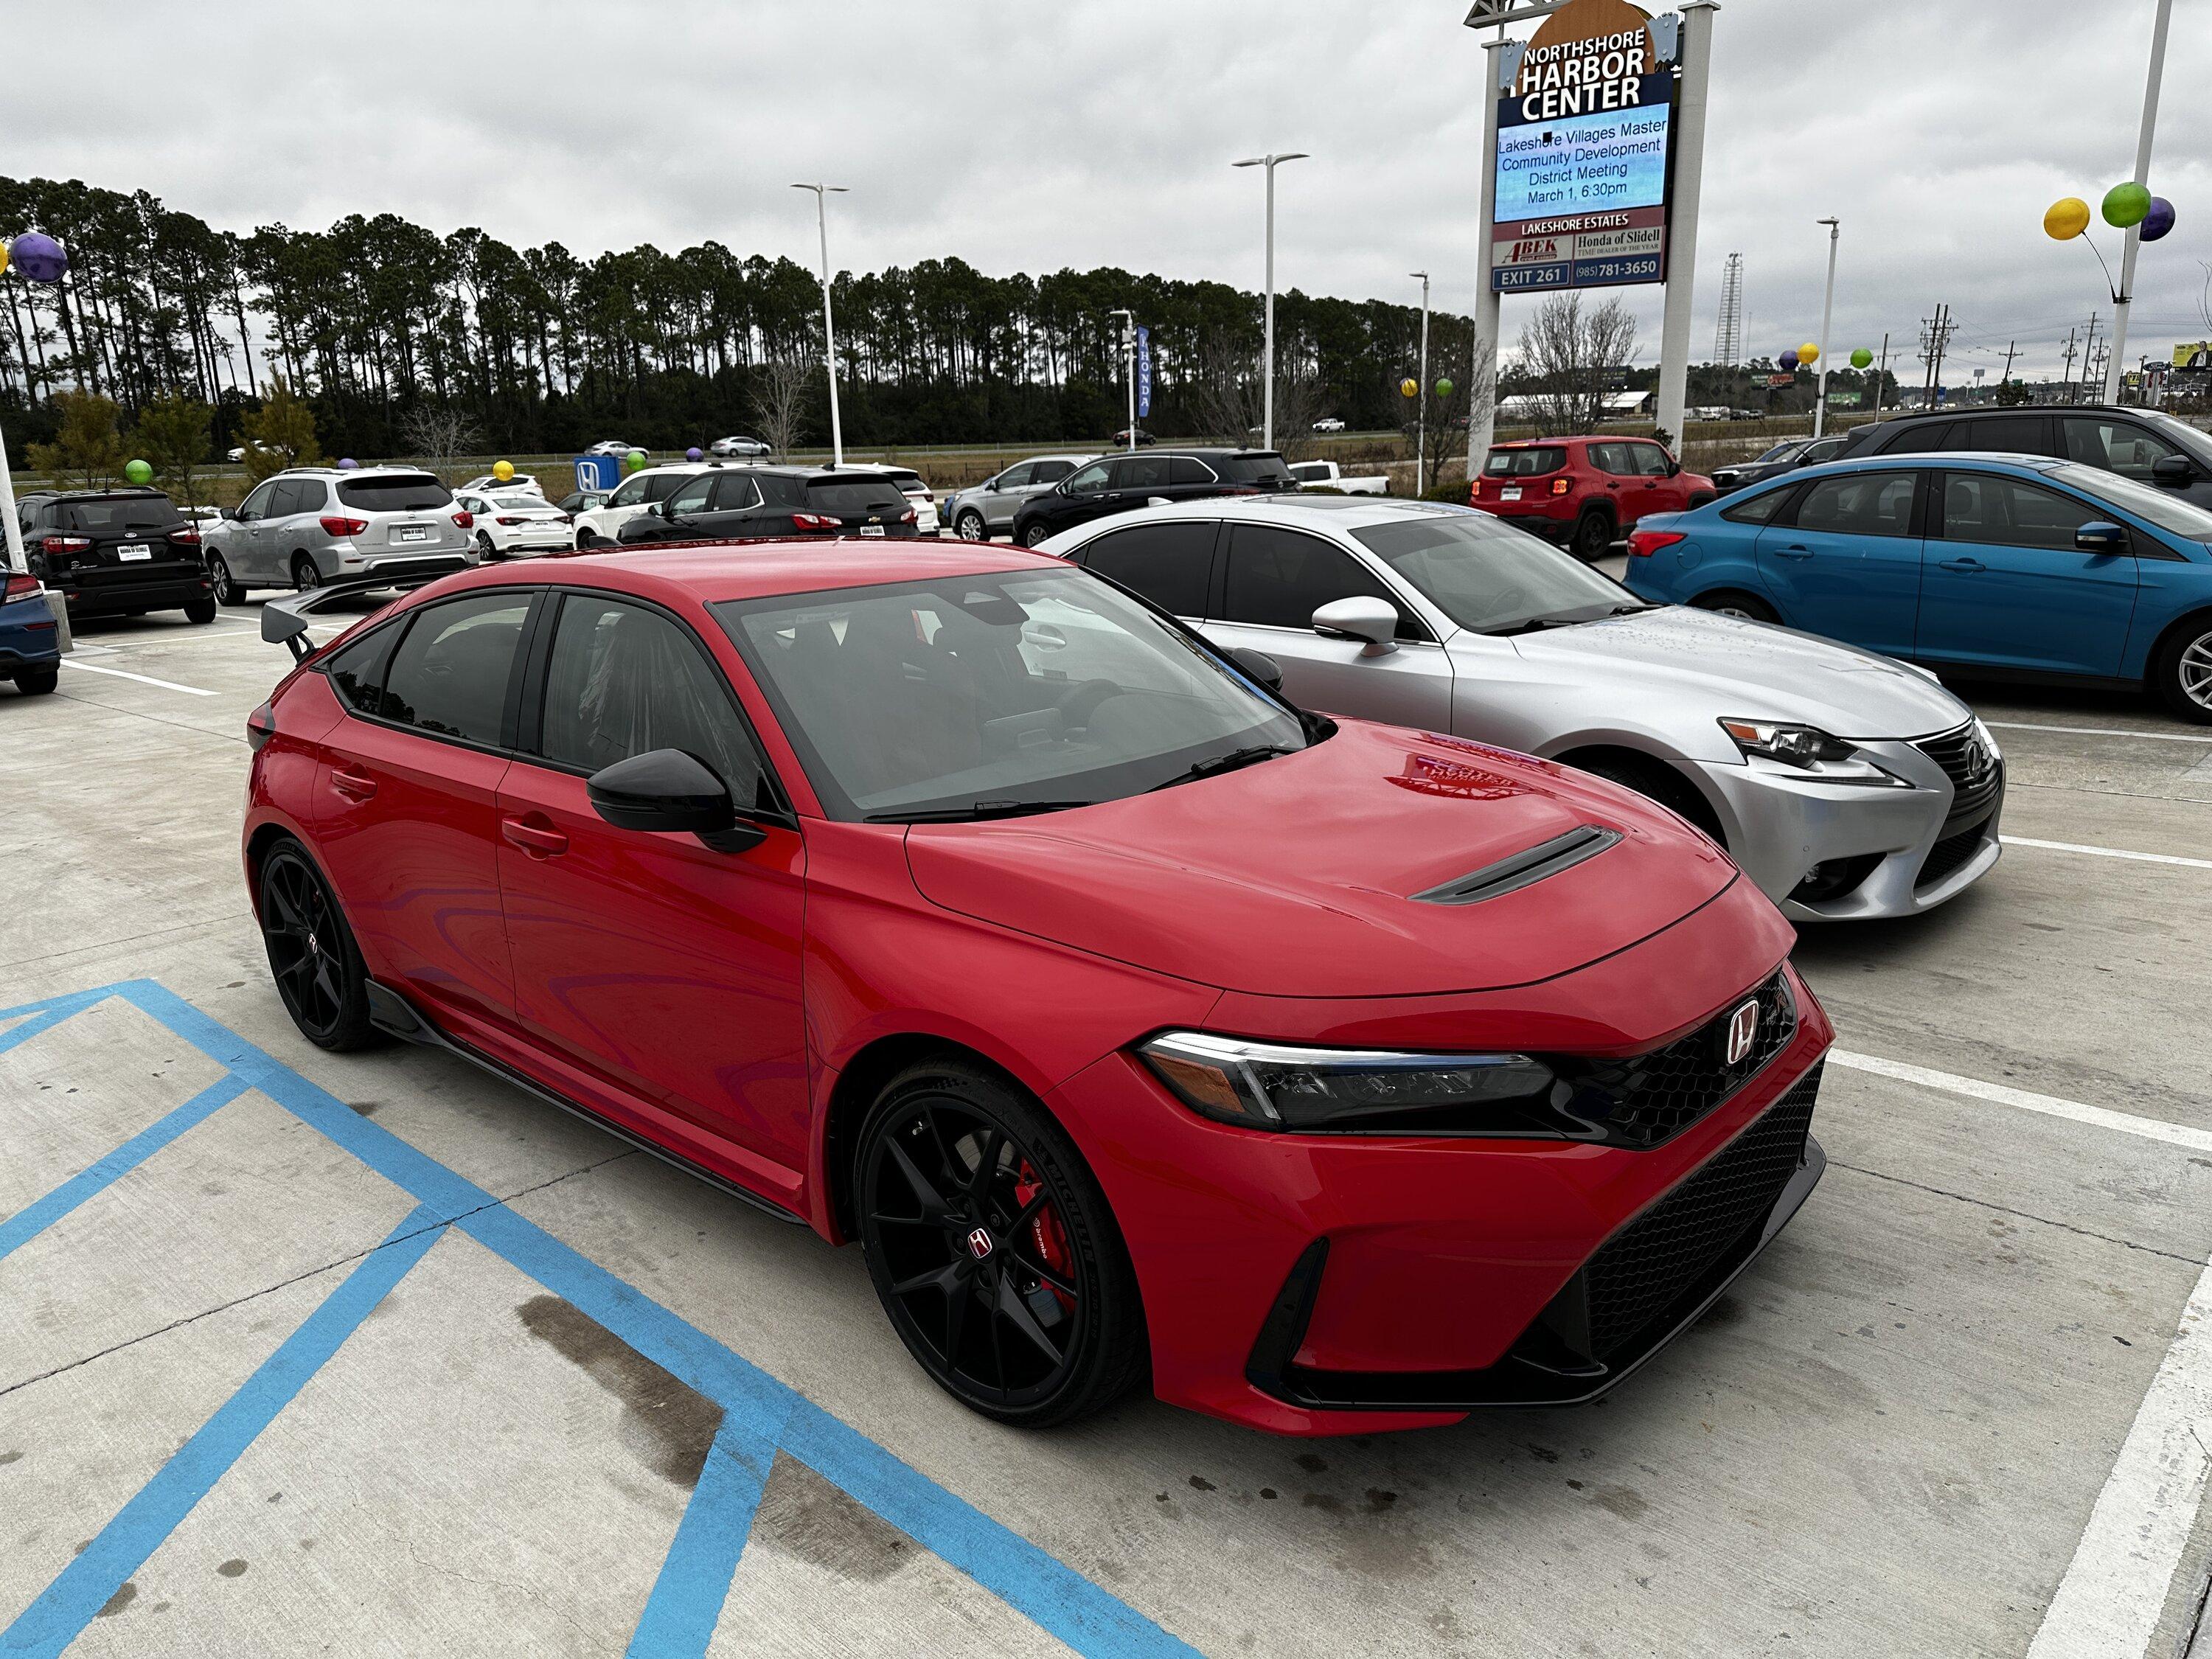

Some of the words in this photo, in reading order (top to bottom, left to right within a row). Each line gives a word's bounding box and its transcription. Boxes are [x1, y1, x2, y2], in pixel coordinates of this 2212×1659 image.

[1524, 29, 1645, 66] NORTHSHORE
[1522, 48, 1644, 94] HARBOR
[1522, 77, 1641, 121] CENTER
[1566, 128, 1615, 145] Villages
[1621, 120, 1666, 136] Master
[1502, 151, 1571, 171] Community
[1575, 138, 1660, 161] Development
[1529, 169, 1573, 186] District
[1577, 163, 1627, 180] Meeting
[1528, 188, 1563, 204] March
[1568, 187, 1576, 201] 1,
[1582, 183, 1627, 198] 6:30pm
[1521, 218, 1582, 235] LAKESHORE
[1585, 213, 1629, 229] ESTATES
[1578, 234, 1612, 248] Honda
[1614, 232, 1625, 245] of
[1627, 229, 1660, 243] Slidell
[1578, 248, 1596, 257] TIME
[1501, 271, 1532, 285] EXIT
[1536, 268, 1560, 282] 261
[1576, 265, 1598, 278] (985)
[1599, 260, 1657, 276] 781-3650
[1140, 351, 1150, 407] HONDA
[1048, 1163, 1095, 1262] MICHELIN
[1035, 1228, 1047, 1259] brembo
